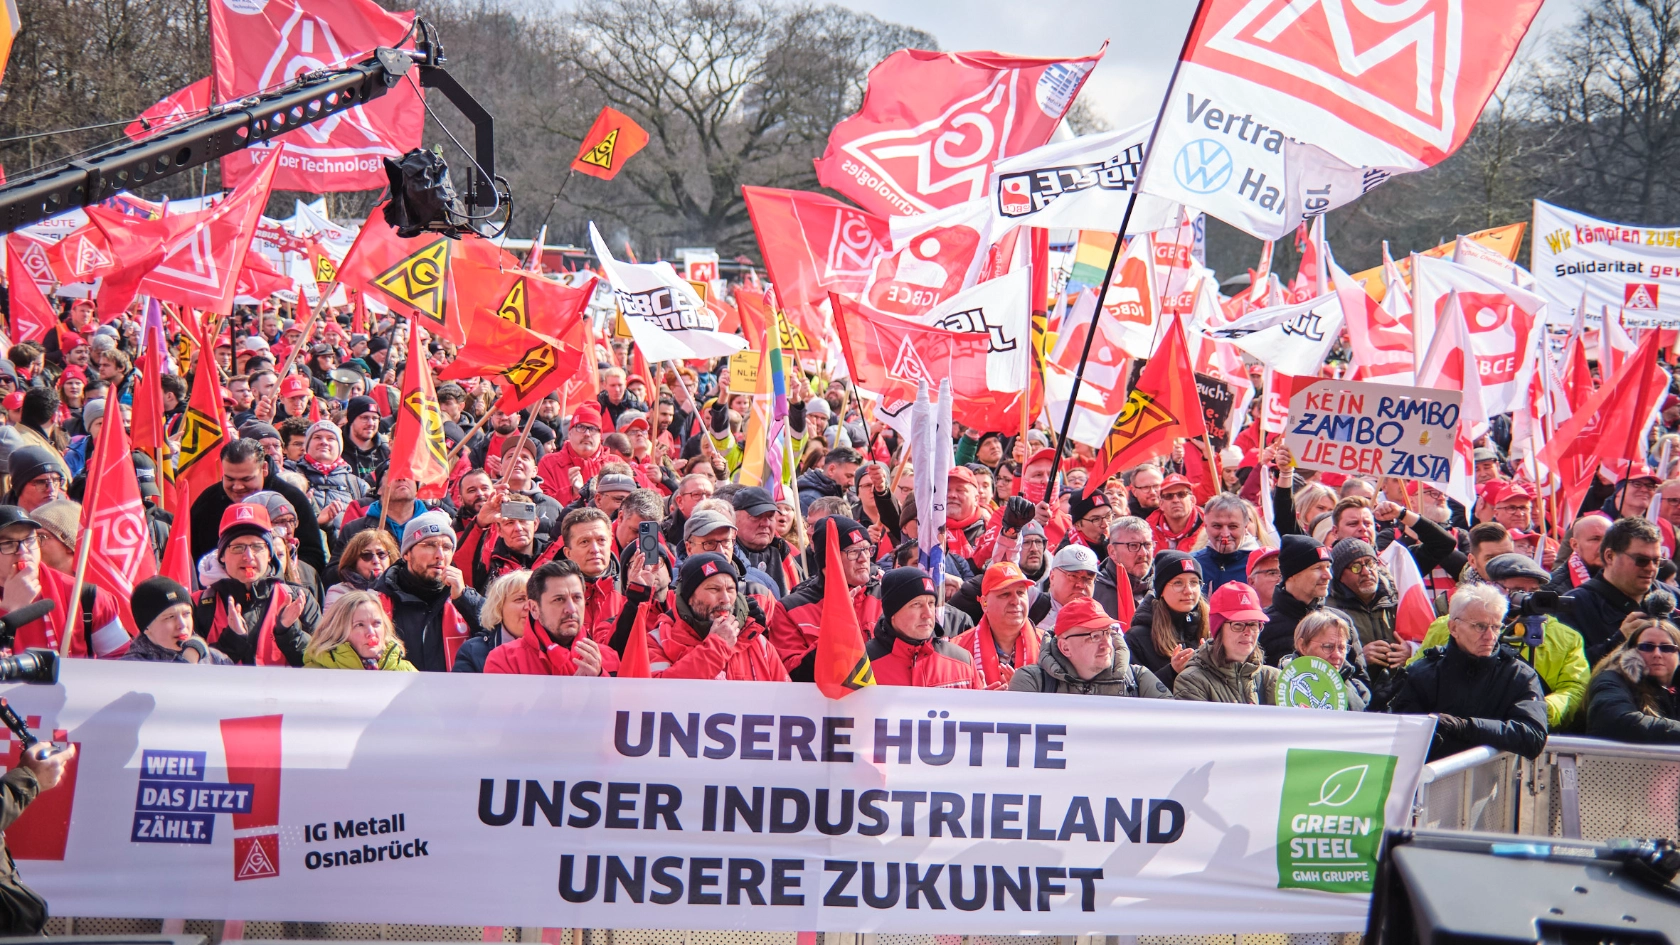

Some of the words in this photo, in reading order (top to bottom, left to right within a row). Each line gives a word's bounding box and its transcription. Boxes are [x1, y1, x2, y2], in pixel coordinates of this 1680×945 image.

[1187, 92, 1285, 155] Vertra
[302, 156, 386, 173] Technologi
[1545, 228, 1571, 255] Wir
[1555, 261, 1644, 277] Solidarität
[1479, 356, 1516, 376] BCE
[1305, 391, 1364, 414] KEIN
[1377, 396, 1459, 430] RAMBO
[1292, 413, 1404, 447] ZAMBO
[1301, 436, 1383, 475] LIEBER
[1387, 448, 1450, 483] ZASTA
[1311, 659, 1328, 673] WIR
[1327, 669, 1343, 691] SIND
[613, 710, 855, 763] UNSERE
[872, 710, 1067, 769] HÜTTE
[147, 756, 197, 776] WEIL
[142, 788, 185, 807] DAS
[187, 789, 249, 811] JETZT
[477, 778, 683, 831] UNSER
[702, 785, 1186, 844] INDUSTRIELAND
[137, 815, 206, 839] ZÄHLT.
[304, 823, 327, 843] IG
[334, 813, 405, 840] Metall
[1291, 813, 1371, 836] GREEN
[304, 838, 429, 870] Osnabrück
[1290, 837, 1358, 858] STEEL
[558, 854, 805, 906] UNSERE
[823, 859, 1104, 912] ZUKUNFT
[1292, 870, 1320, 882] GMH
[1322, 870, 1370, 882] GRUPPE
